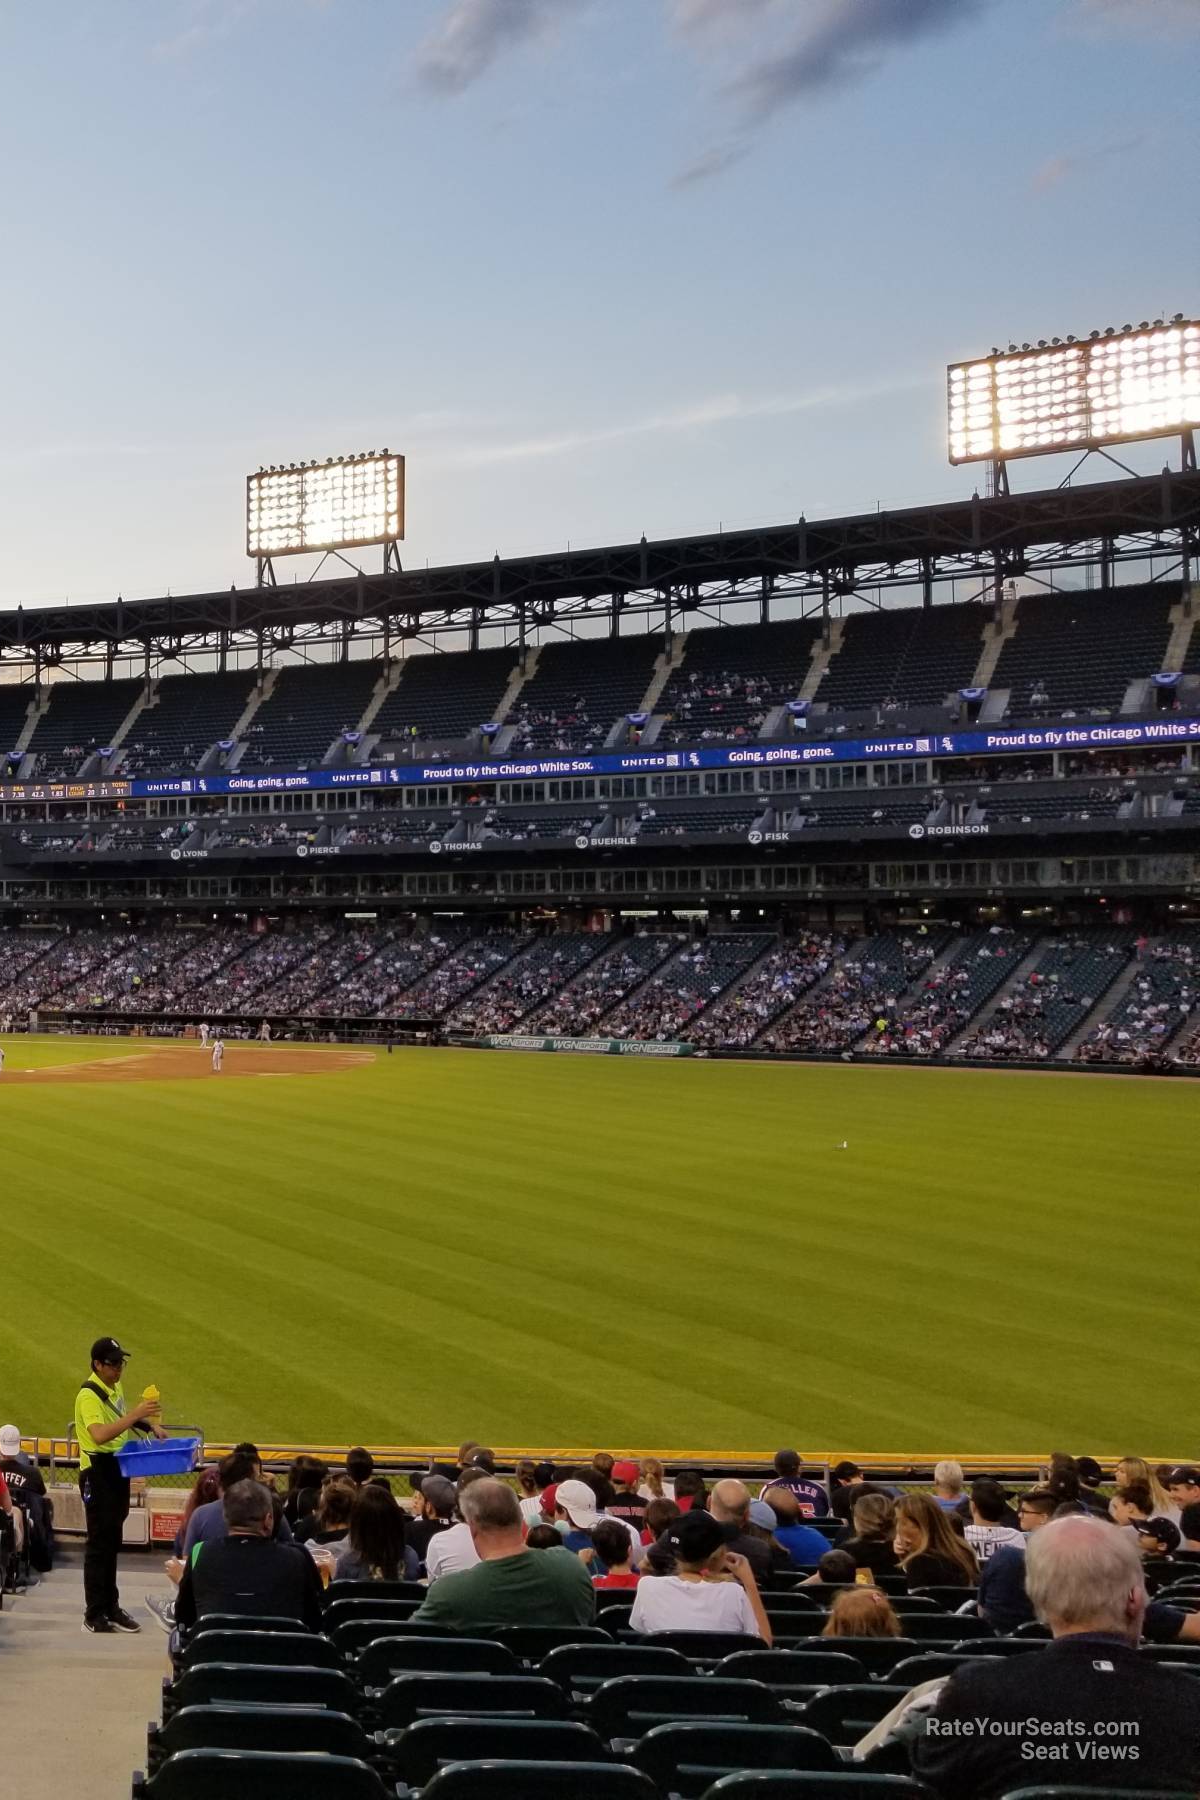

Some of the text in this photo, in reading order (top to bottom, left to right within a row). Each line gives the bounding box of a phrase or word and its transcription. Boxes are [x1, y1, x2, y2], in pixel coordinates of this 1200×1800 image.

[987, 723, 1200, 747] Proud to fly the Chicago White S
[865, 743, 914, 752] UNITED
[729, 747, 835, 762] Going, going, gone.
[621, 757, 665, 767] UNITED
[423, 761, 594, 780] Proud to fly the Chicago White Sox.
[229, 777, 309, 789] Going, going, gone.
[332, 774, 369, 782] UNITED
[927, 825, 989, 834] ROBINSON
[591, 837, 637, 846] BUEHRLE
[765, 832, 789, 841] FISK
[310, 846, 340, 855] PIERCE
[444, 842, 482, 850] THOMAS
[490, 1037, 545, 1048] WGN SPORTS
[553, 1040, 609, 1051] WGN SPORTS
[619, 1043, 648, 1053] WGN
